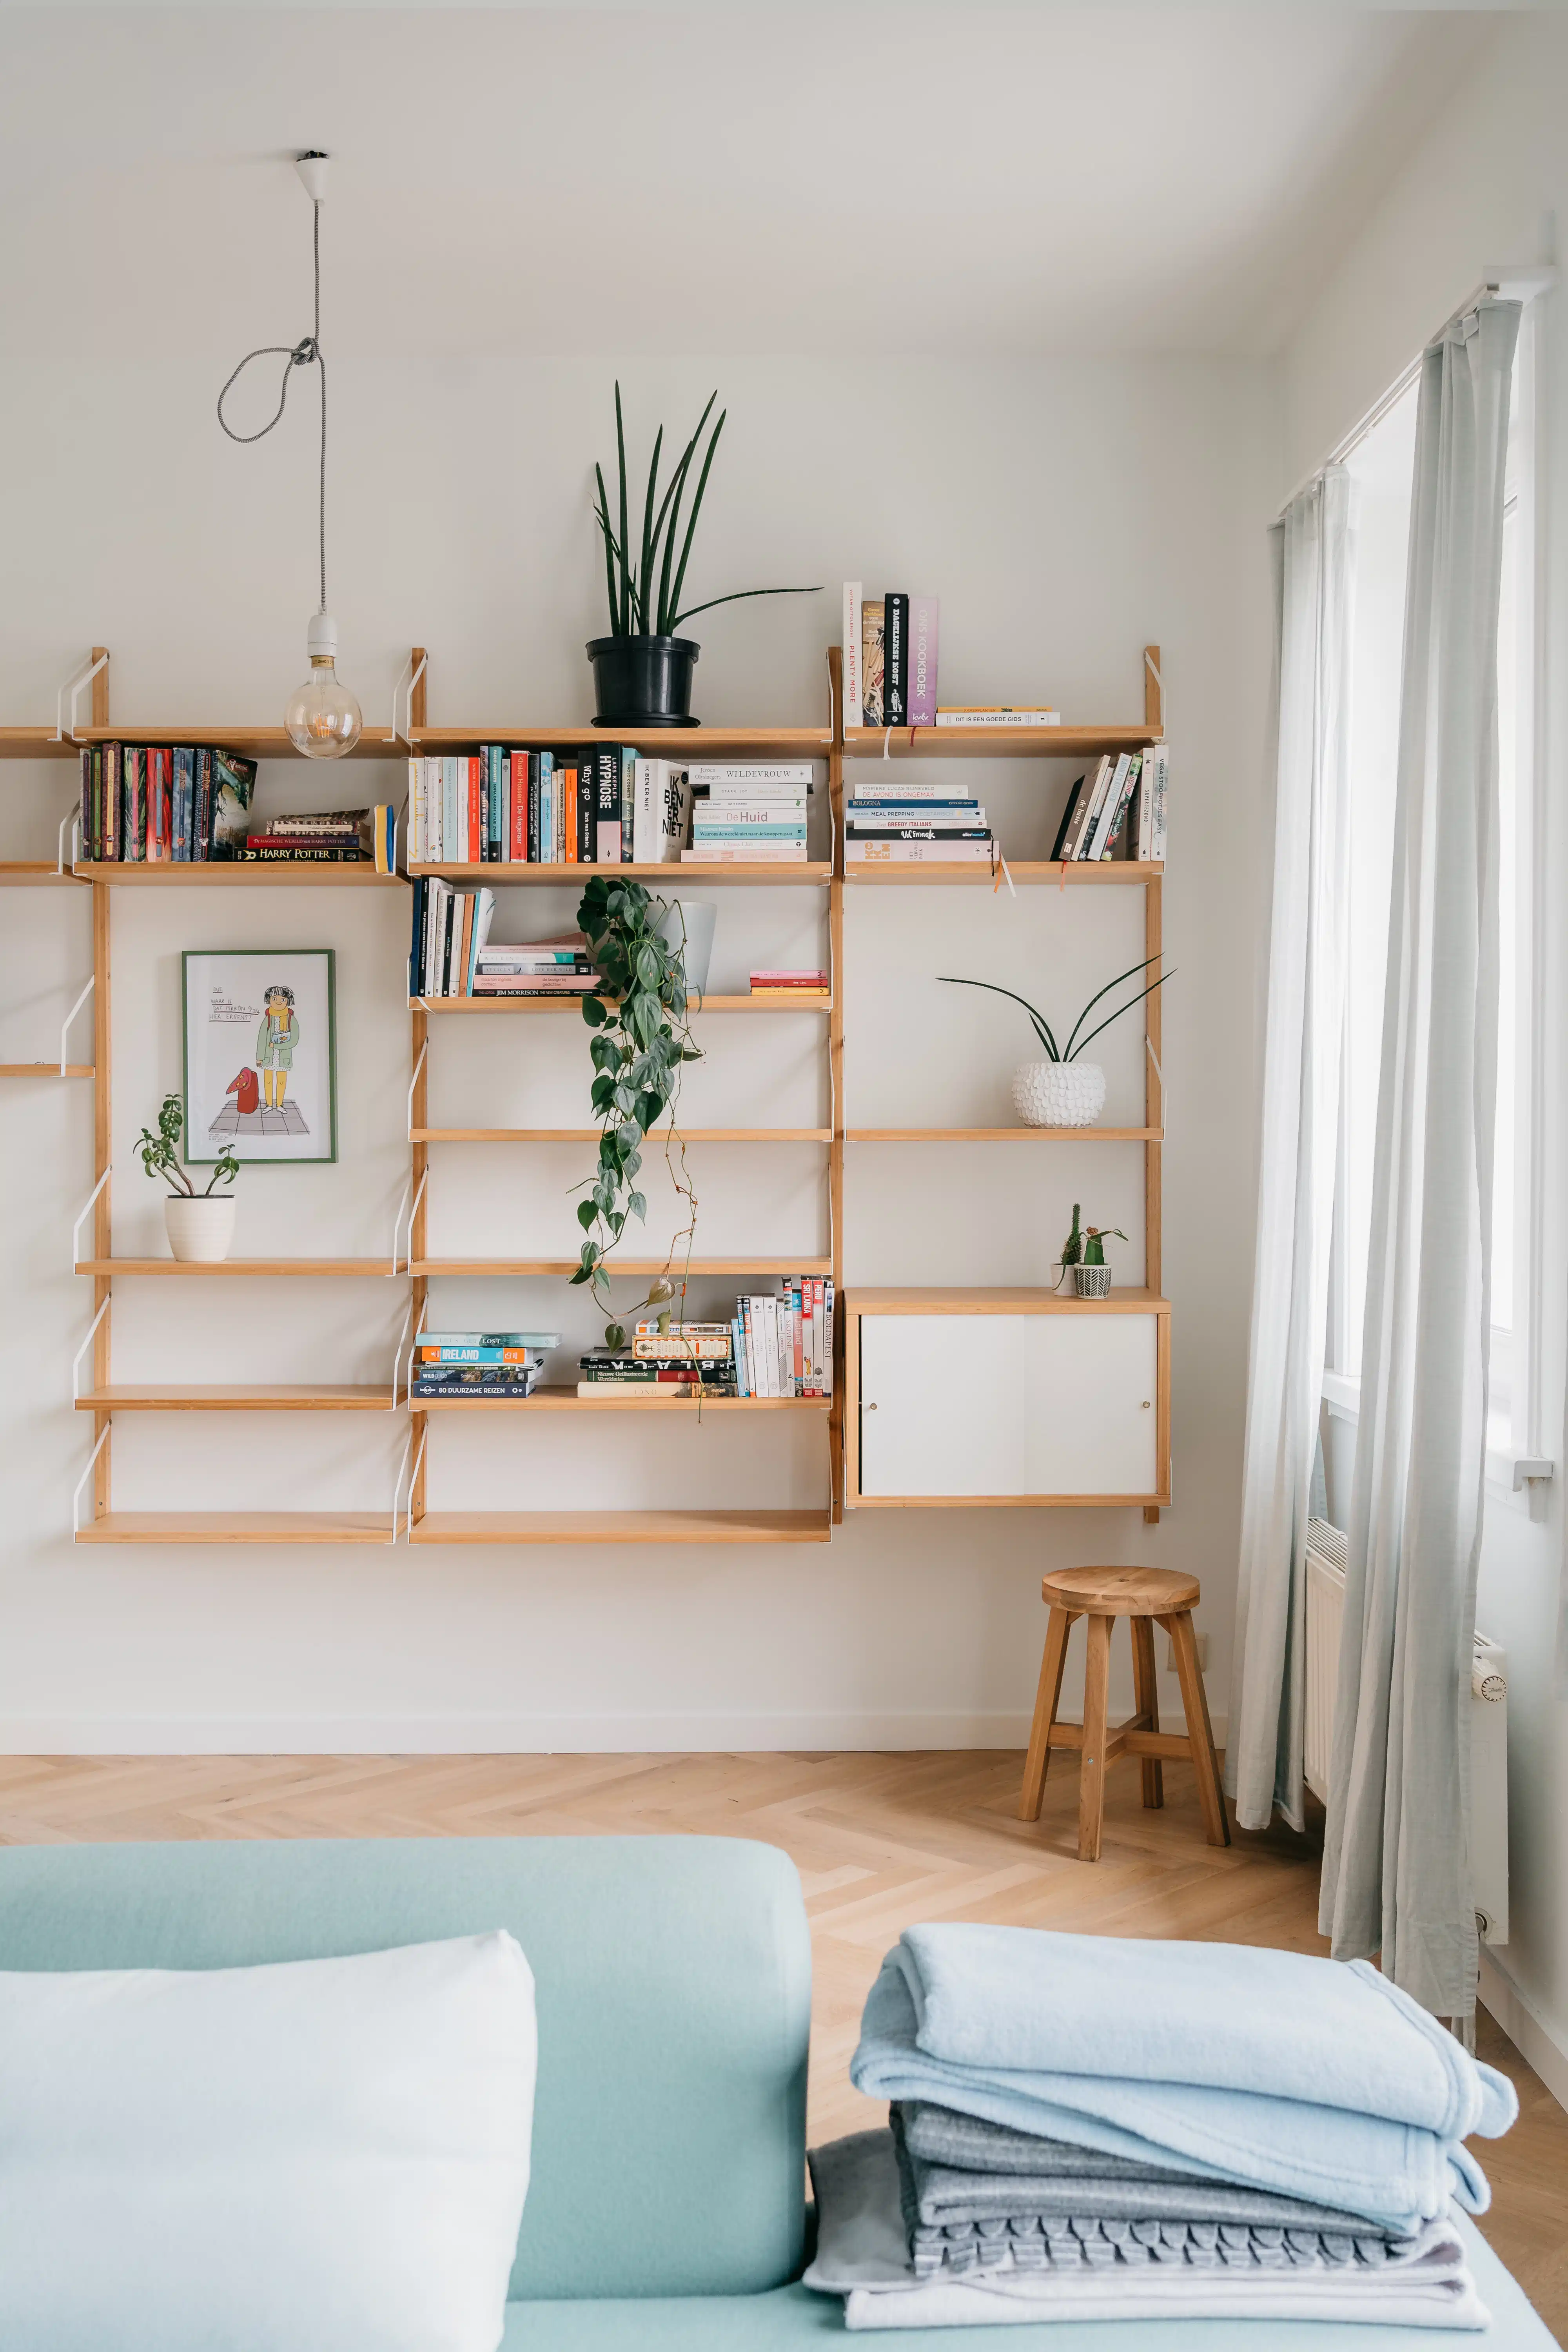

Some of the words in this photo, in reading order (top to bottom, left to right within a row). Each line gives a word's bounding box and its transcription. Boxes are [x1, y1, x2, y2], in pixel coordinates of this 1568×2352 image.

[918, 610, 927, 632] ONS
[916, 636, 927, 698] KOOKBOEK
[600, 756, 612, 808] HYPNOSE
[1126, 776, 1135, 794] GEZOND
[582, 788, 590, 800] go
[664, 789, 684, 808] BEN
[517, 806, 523, 814] De
[1080, 800, 1087, 808] de
[667, 806, 679, 823] ER
[740, 811, 768, 822] Huid
[1074, 808, 1085, 825] basis
[1115, 809, 1124, 823] Karolien
[662, 819, 684, 838] NIET
[260, 849, 292, 858] HARRY
[295, 849, 331, 858] POTTER
[442, 1349, 479, 1360] IRELAND
